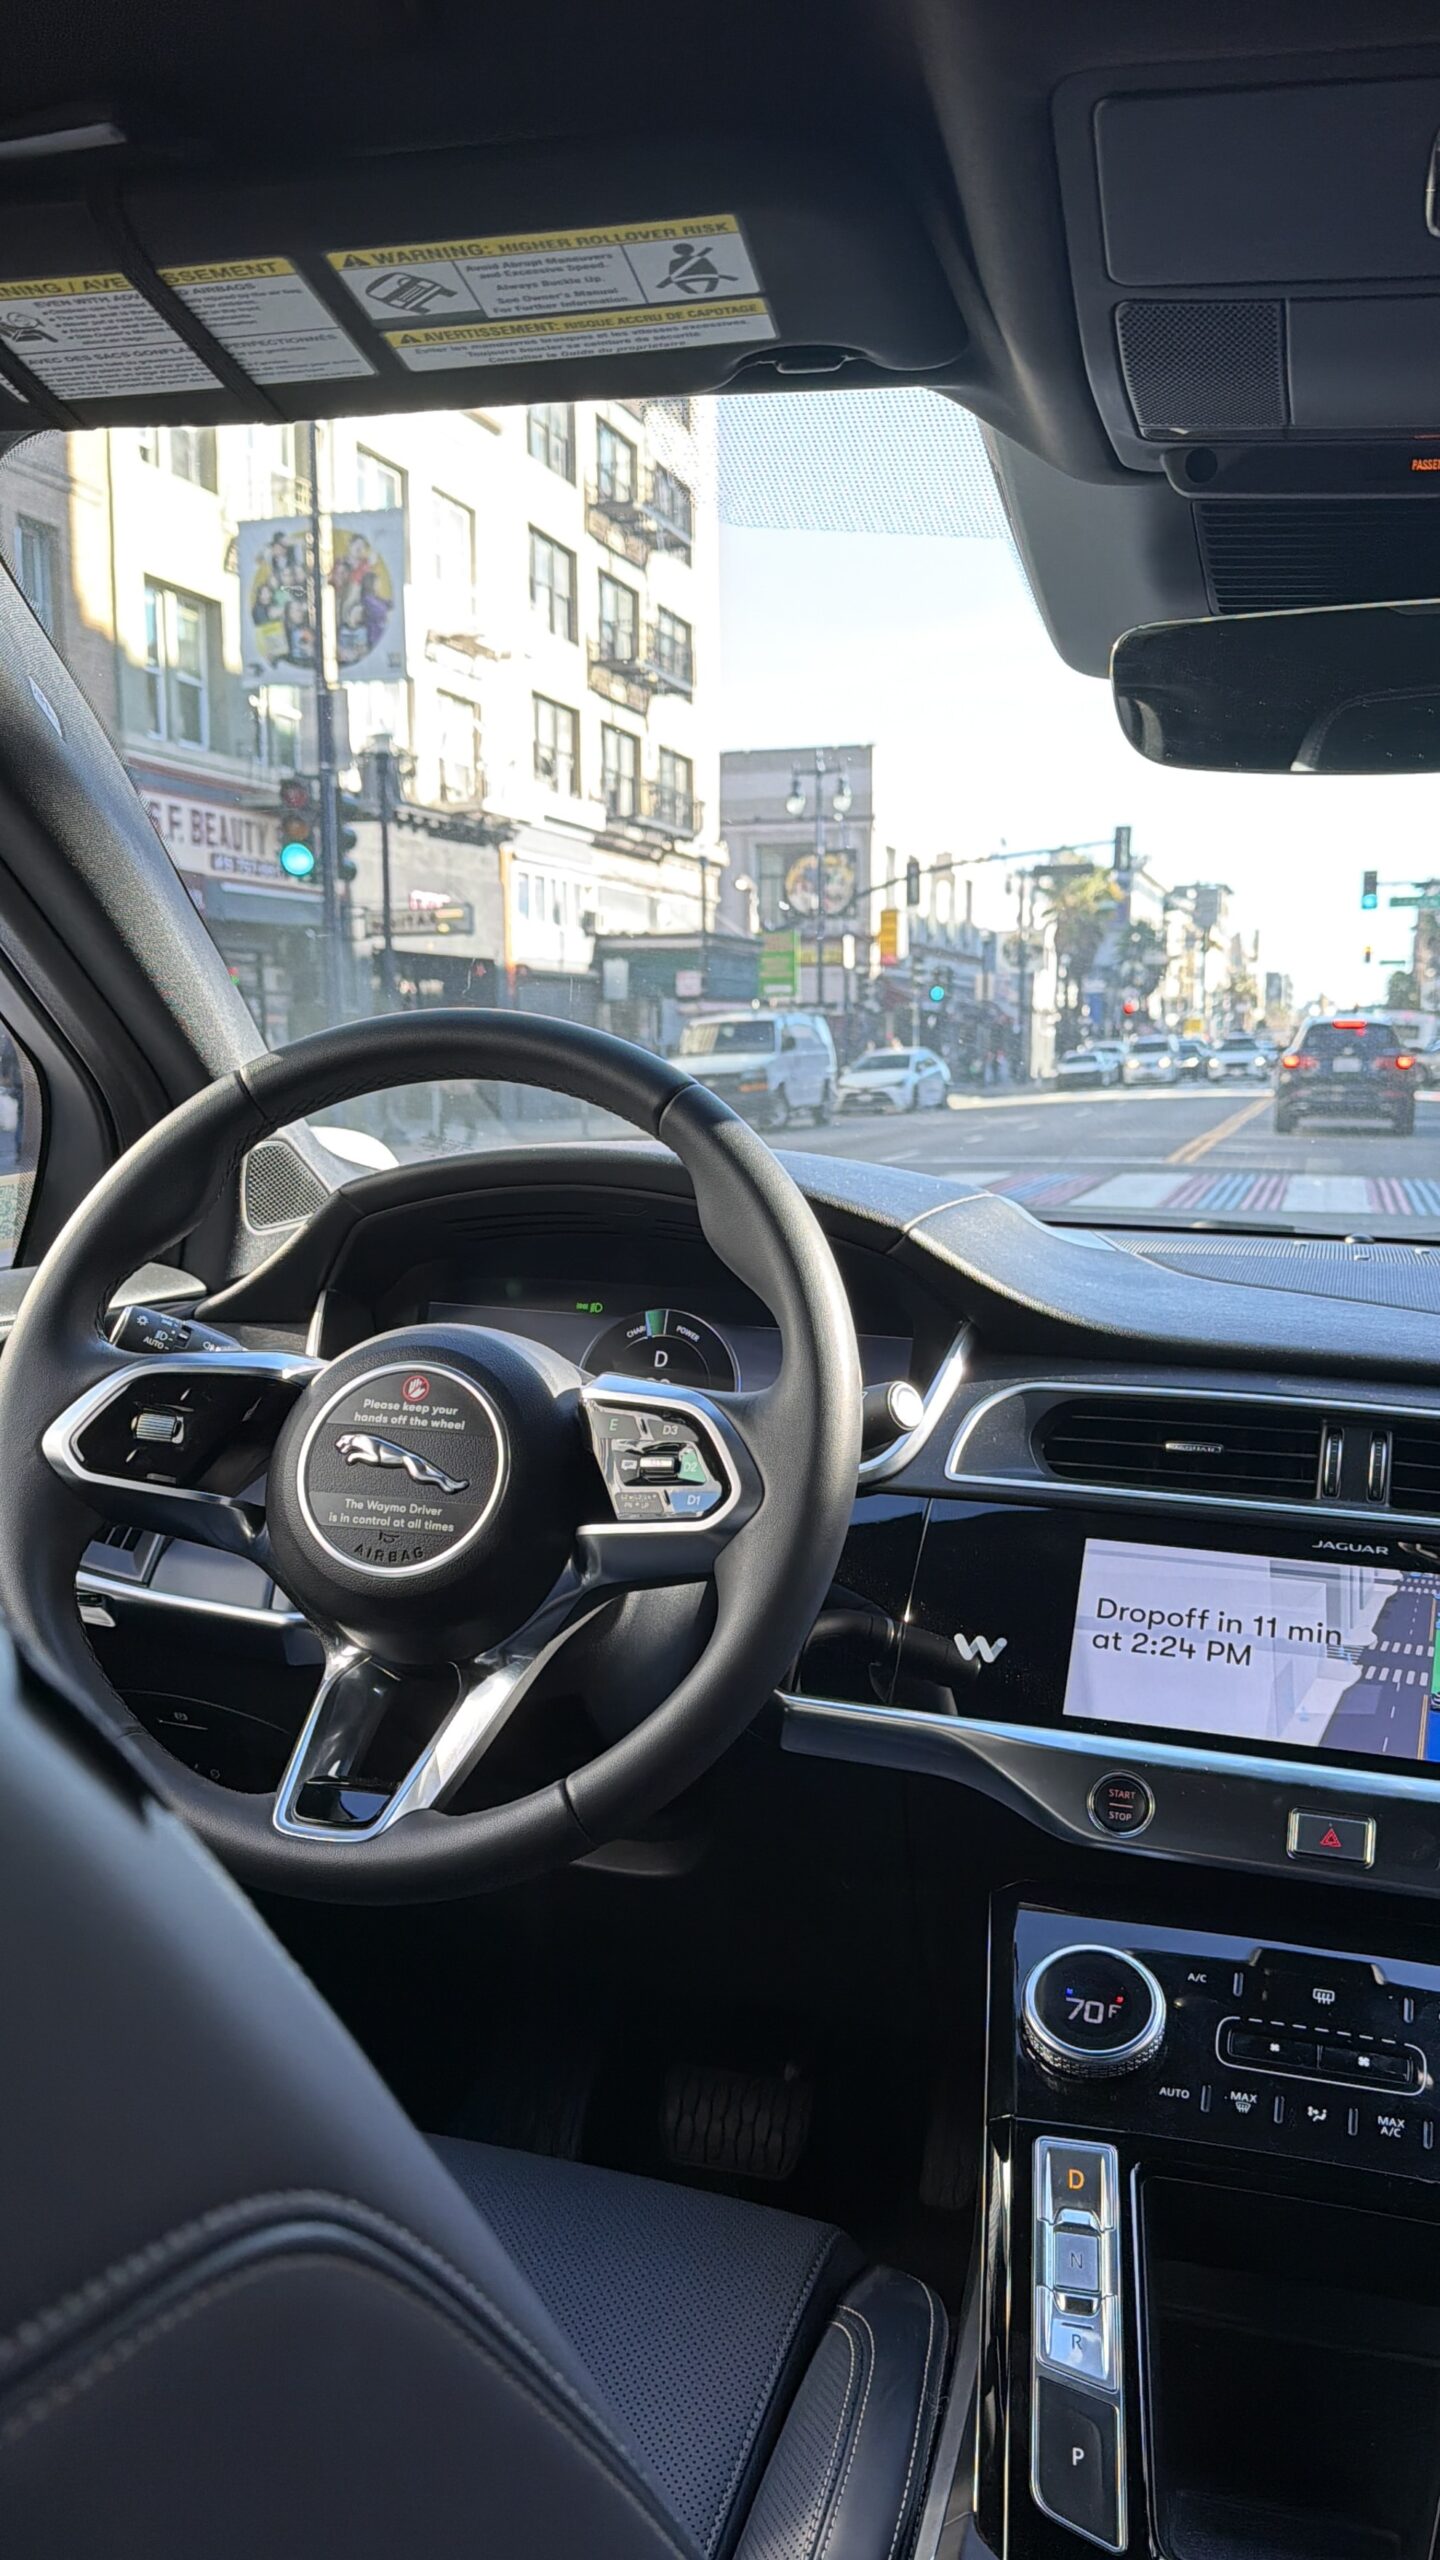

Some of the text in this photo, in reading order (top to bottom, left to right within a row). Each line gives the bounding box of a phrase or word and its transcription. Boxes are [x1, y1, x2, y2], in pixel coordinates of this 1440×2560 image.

[371, 222, 729, 265] WARNING: HIGHER ROLLOVER RISK
[0, 281, 62, 297] NING
[423, 304, 757, 343] AVERTISSEMENT: RISQUE ACCRU DE CAPOTAGE
[150, 802, 269, 856] SF. BEAUTY
[626, 1324, 700, 1342] CHAR POWER
[143, 1336, 164, 1350] AUTO
[654, 1350, 669, 1368] D
[363, 1398, 459, 1417] Please keep your
[354, 1412, 466, 1430] hands off the wheel
[662, 1424, 678, 1436] D3
[683, 1461, 698, 1472] D2
[344, 1498, 443, 1516] The Waymo Driver
[687, 1495, 701, 1505] D1
[329, 1512, 454, 1532] is in control at all times
[354, 1543, 424, 1562] AIRBAG
[1311, 1539, 1389, 1556] JAGUAR
[1095, 1597, 1343, 1646] Dropoff in 11 min
[1092, 1630, 1253, 1667] at 2:24 PM
[1108, 1787, 1137, 1801] START
[1108, 1810, 1133, 1822] STOP
[1187, 1972, 1208, 1983] A/C
[1158, 2086, 1191, 2100] AUTO
[1230, 2090, 1258, 2104] MAX
[1377, 2114, 1406, 2129] MAX
[1379, 2124, 1403, 2138] A/C
[1068, 2168, 1085, 2190] D
[1070, 2251, 1084, 2269] N
[1071, 2333, 1083, 2350] R
[1072, 2446, 1085, 2465] P
